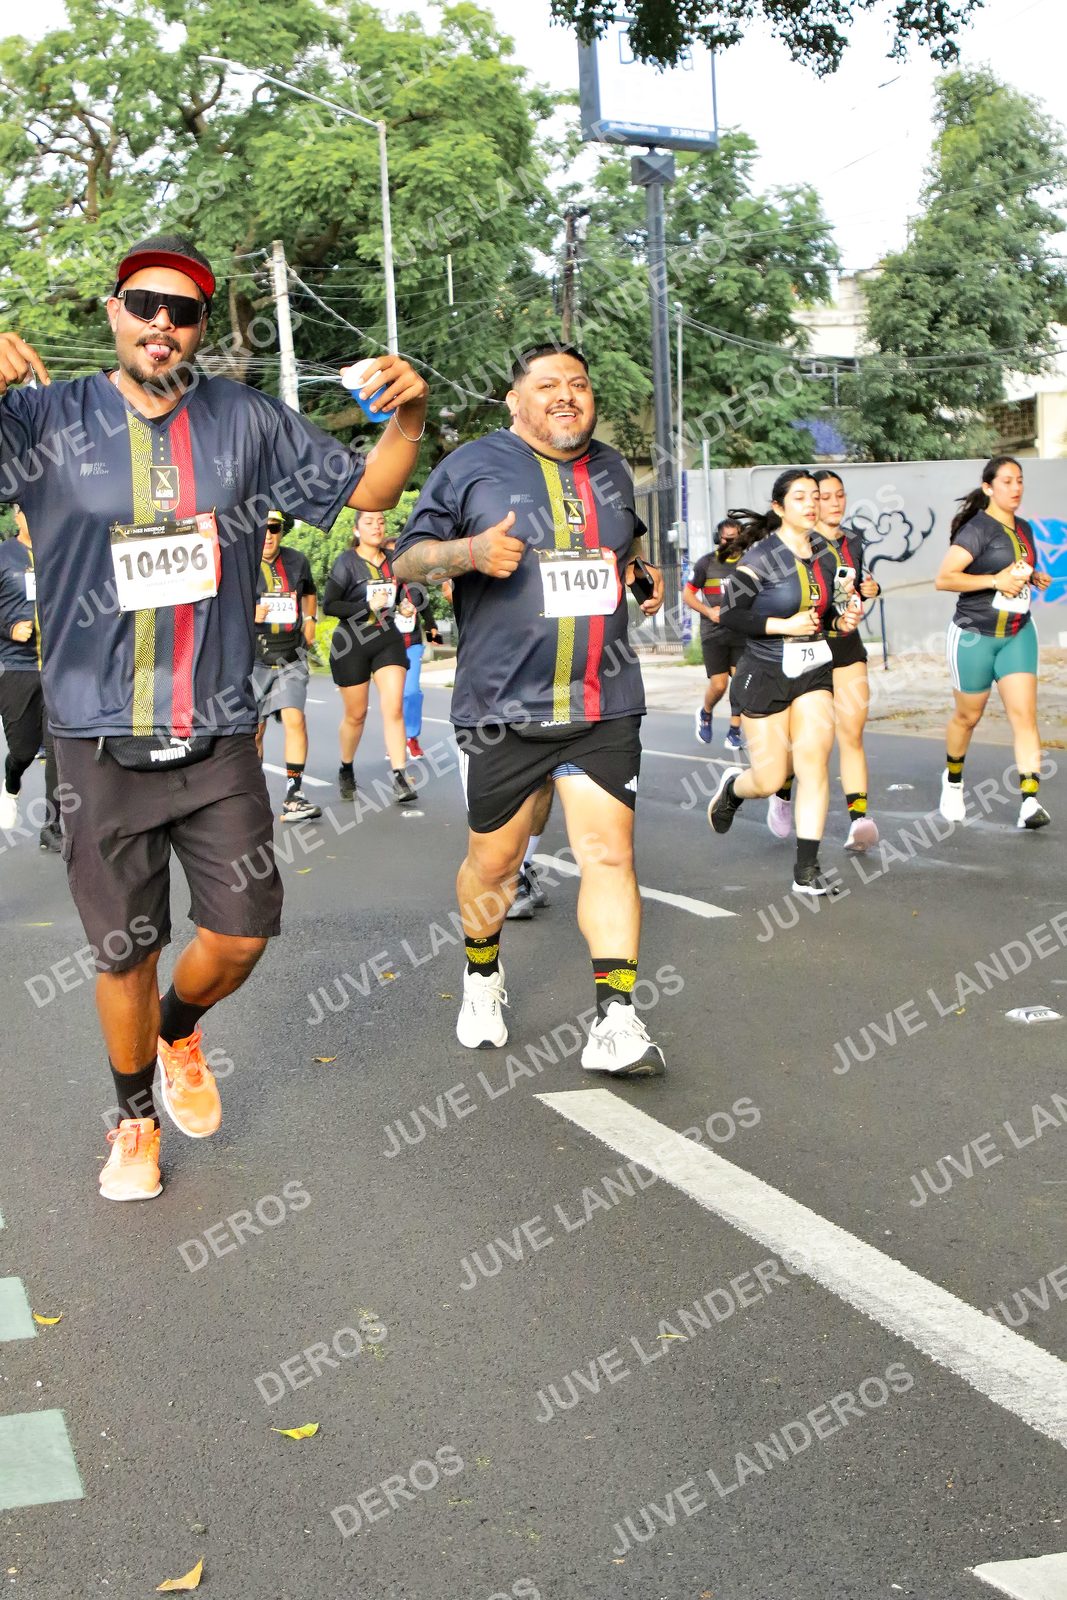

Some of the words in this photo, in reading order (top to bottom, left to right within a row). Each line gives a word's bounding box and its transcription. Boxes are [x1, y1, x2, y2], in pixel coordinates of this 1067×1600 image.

[119, 543, 208, 581] 10496
[547, 568, 610, 592] 11407
[268, 601, 294, 611] 2324
[150, 746, 186, 762] PUMA
